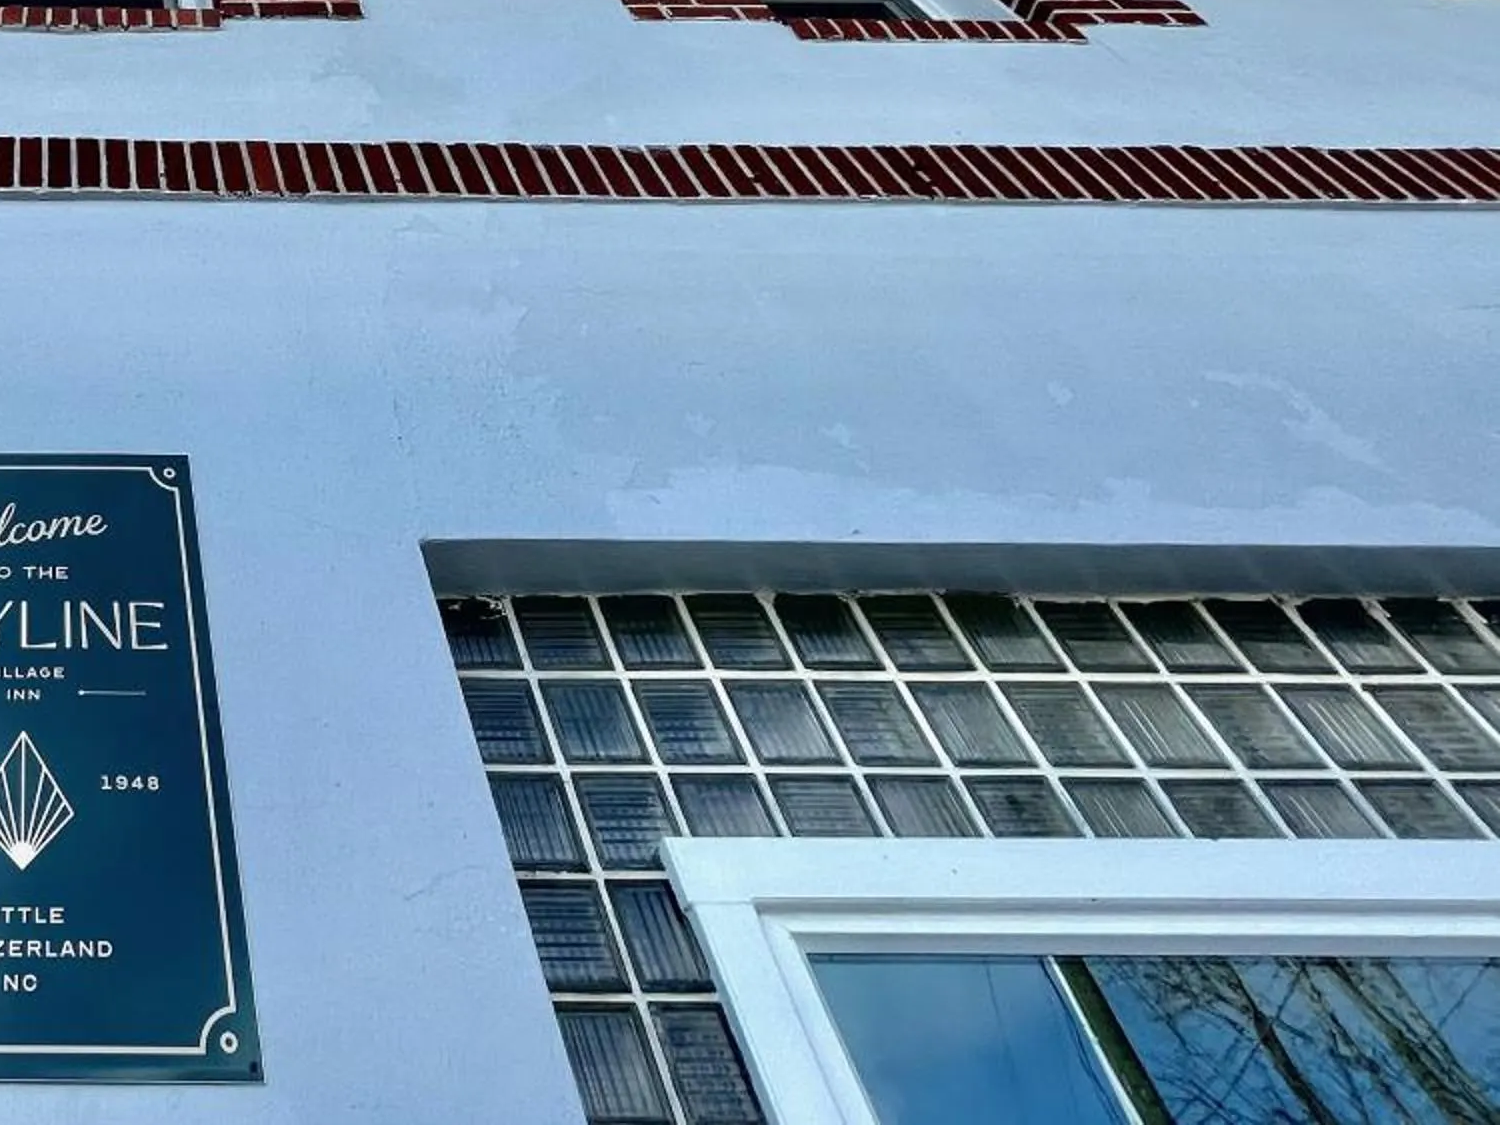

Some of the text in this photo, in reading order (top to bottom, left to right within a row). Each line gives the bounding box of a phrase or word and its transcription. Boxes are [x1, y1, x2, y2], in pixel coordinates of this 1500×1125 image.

[22, 566, 69, 580] THE
[7, 689, 40, 700] INN
[101, 775, 159, 791] 1948
[3, 974, 37, 992] NC
